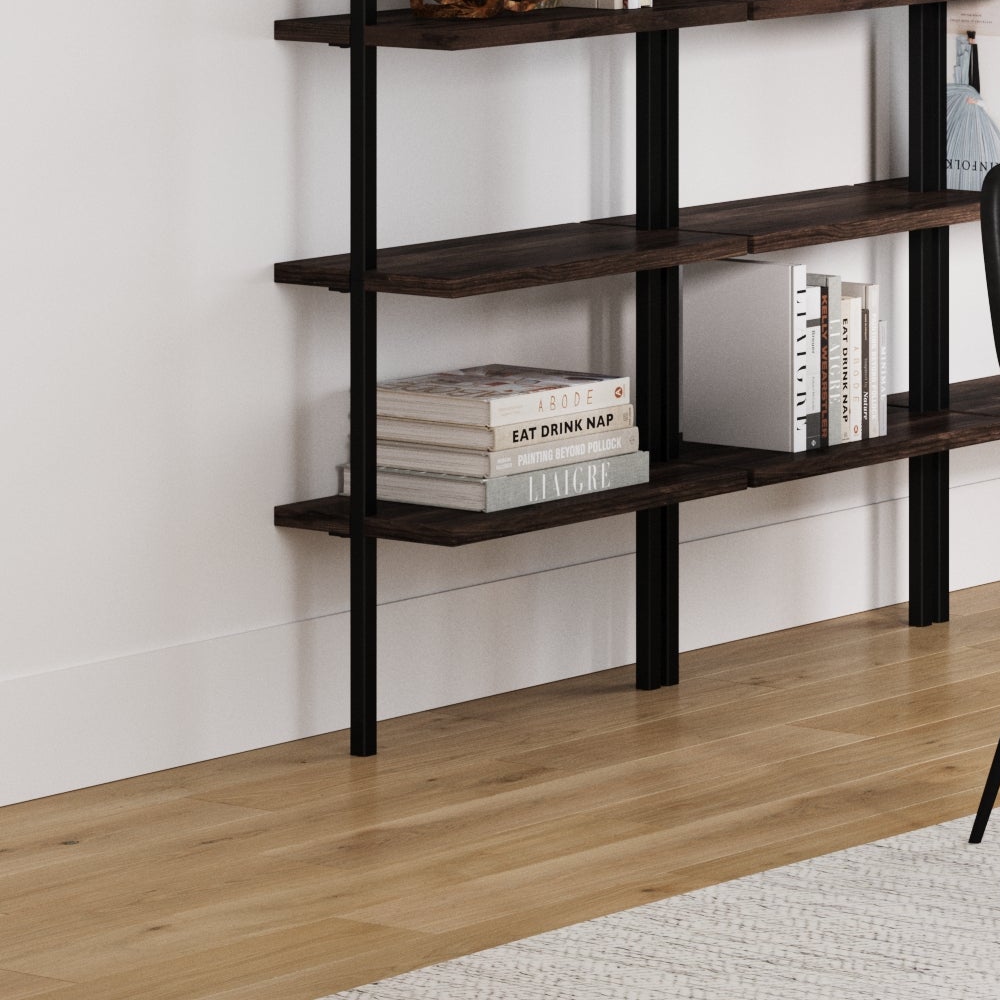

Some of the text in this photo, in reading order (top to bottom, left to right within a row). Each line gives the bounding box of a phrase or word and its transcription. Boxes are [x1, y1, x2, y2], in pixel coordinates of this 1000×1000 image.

[946, 159, 999, 171] INFOLK
[829, 319, 841, 404] LIAIGRE
[538, 389, 593, 412] ABODE
[512, 427, 537, 443] EAT
[541, 418, 583, 438] DRINK
[586, 413, 614, 430] NAP
[517, 449, 553, 467] PAINTING
[555, 444, 586, 460] BEYOND
[588, 437, 622, 454] POLLOCK
[528, 462, 611, 502] LIAIGRE
